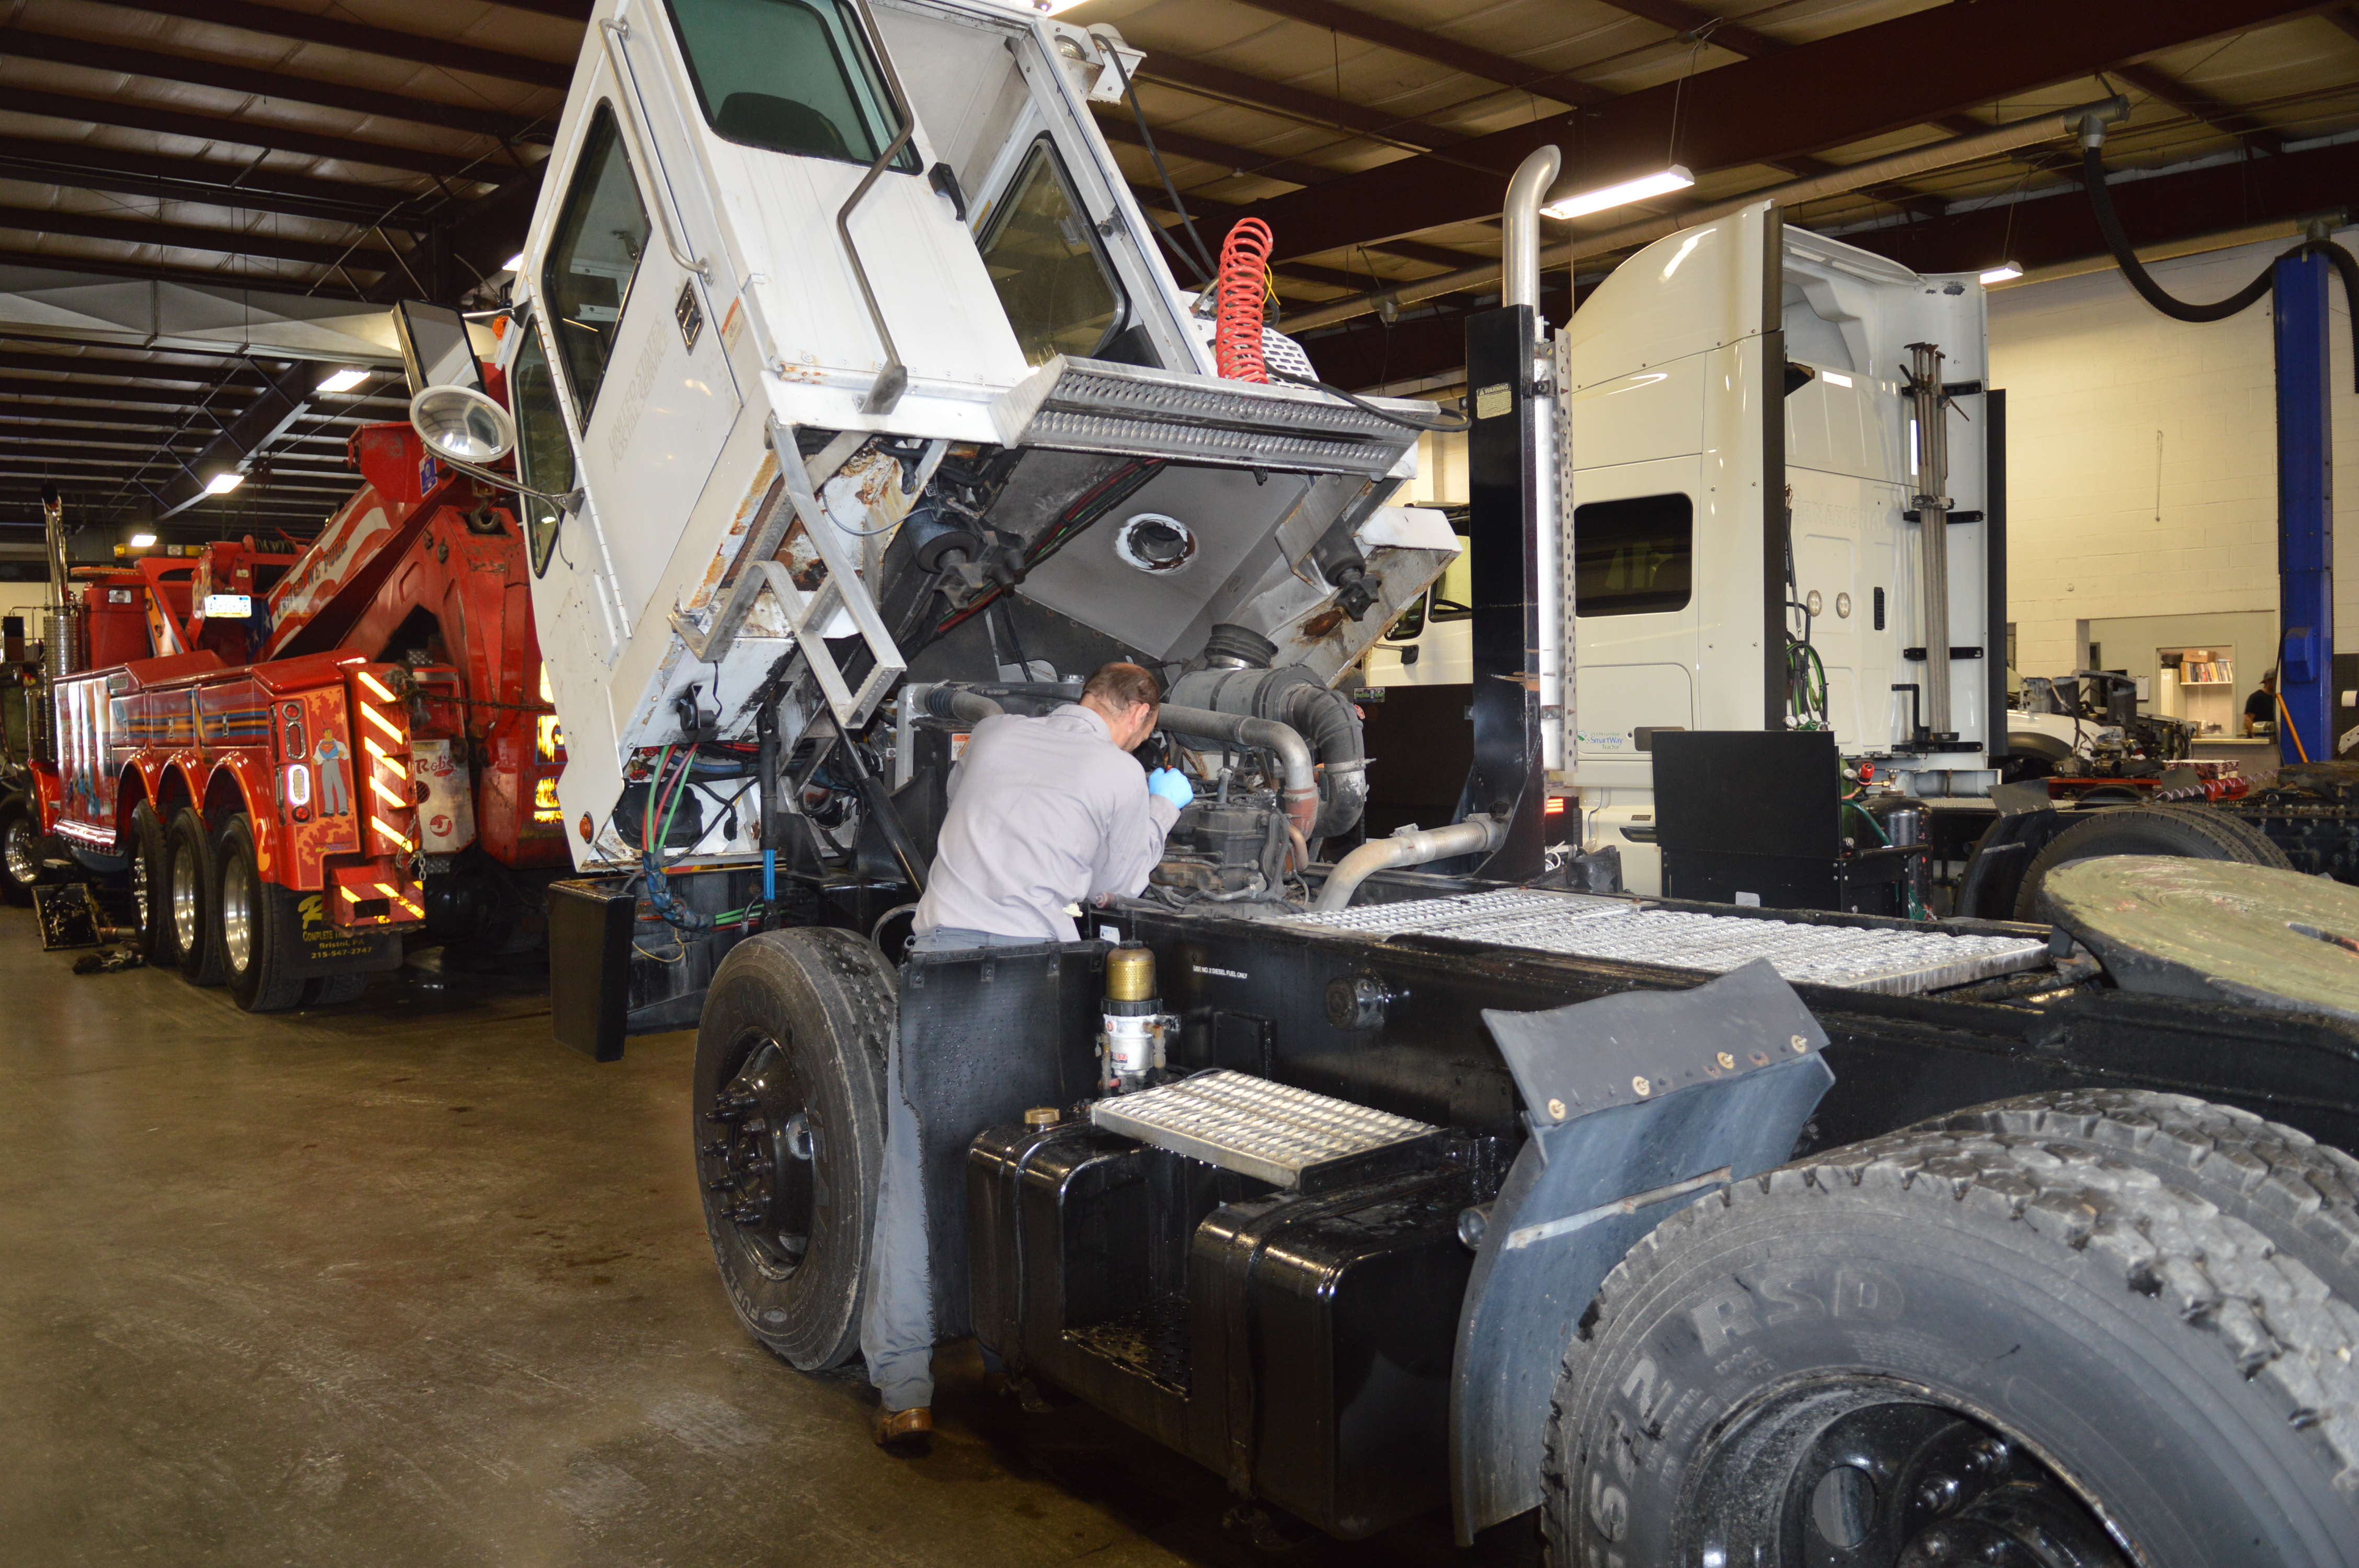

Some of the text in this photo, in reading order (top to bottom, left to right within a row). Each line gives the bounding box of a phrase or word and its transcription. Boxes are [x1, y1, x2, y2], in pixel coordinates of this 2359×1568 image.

[609, 312, 662, 452] UNITED STATES
[1485, 384, 1508, 394] WARNING
[612, 331, 670, 474] POSTAL SERVICE
[1793, 499, 1889, 532] ERNATIONAL
[277, 575, 304, 620] UNITED
[306, 560, 320, 586] WE
[324, 534, 348, 573] PULL
[1590, 736, 1623, 745] SmartWay
[415, 755, 457, 777] Rob's
[303, 930, 333, 941] COMPLETE
[319, 940, 350, 949] Bristol,
[730, 1266, 761, 1322] FUEL
[1692, 1269, 1905, 1357] RSD
